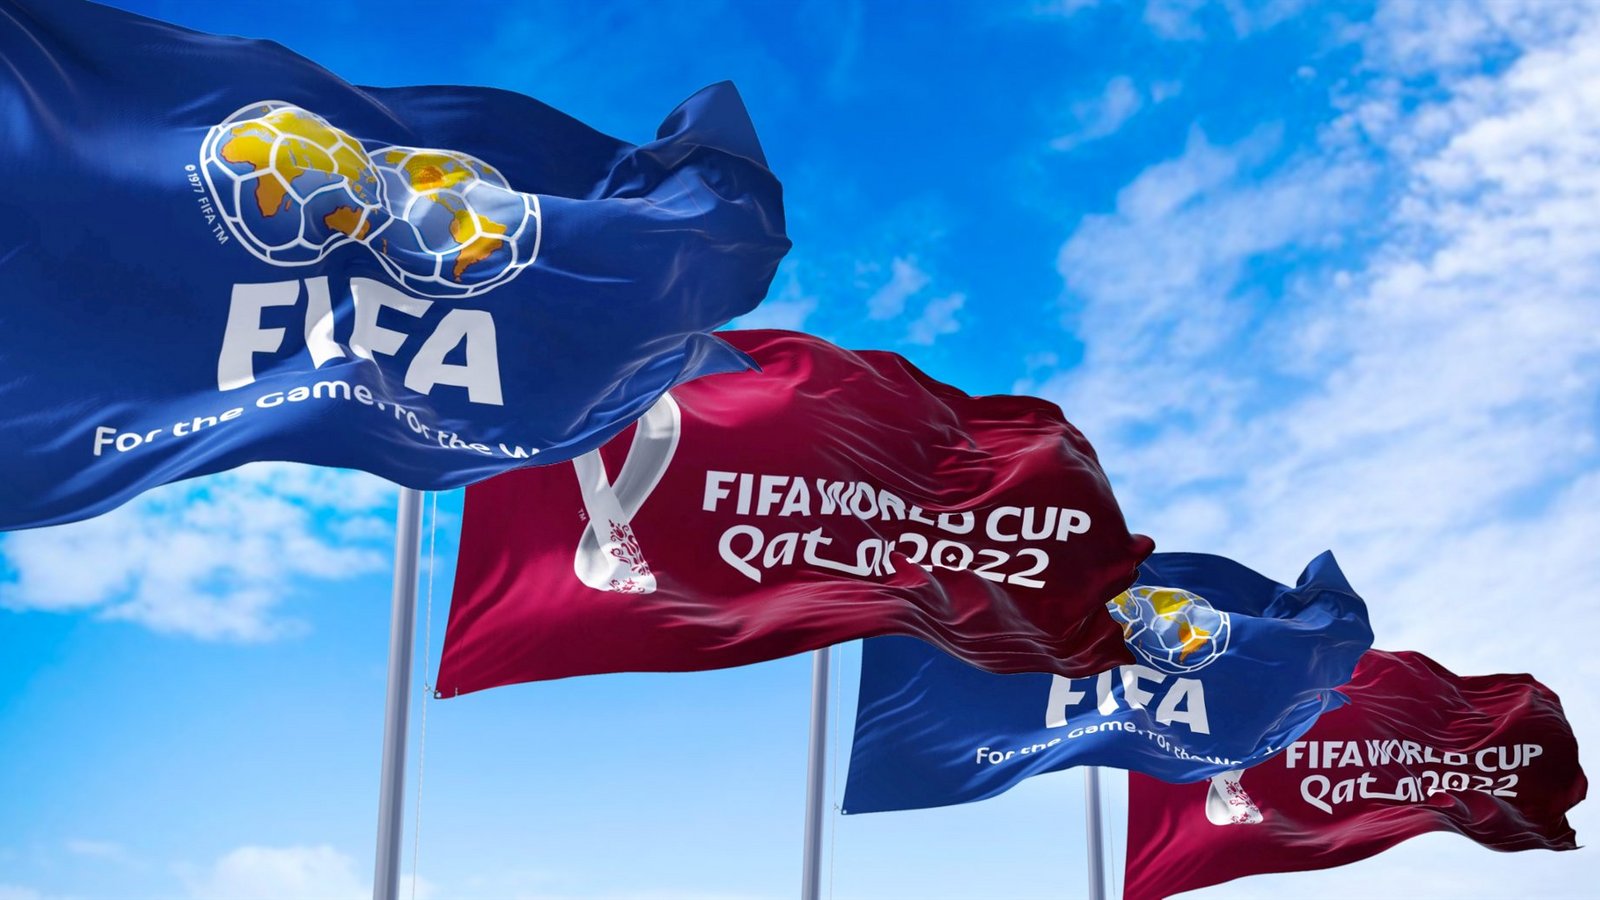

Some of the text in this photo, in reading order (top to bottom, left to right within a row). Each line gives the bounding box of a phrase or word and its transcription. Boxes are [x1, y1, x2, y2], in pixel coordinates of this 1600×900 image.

[198, 196, 216, 225] FIFA
[212, 223, 229, 245] TM
[217, 276, 504, 406] FIFA
[93, 426, 162, 456] For
[172, 407, 244, 437] the
[438, 430, 493, 455] the
[702, 470, 1092, 542] FIFA WORLD CUP
[718, 524, 1050, 589] Qatar 2022
[1046, 664, 1210, 735] FIFA
[976, 747, 1015, 765] For
[1286, 741, 1364, 769] FIFA
[1364, 739, 1469, 766] WORLD
[1475, 743, 1543, 772] CUP
[1300, 770, 1519, 815] Qatar 2022
